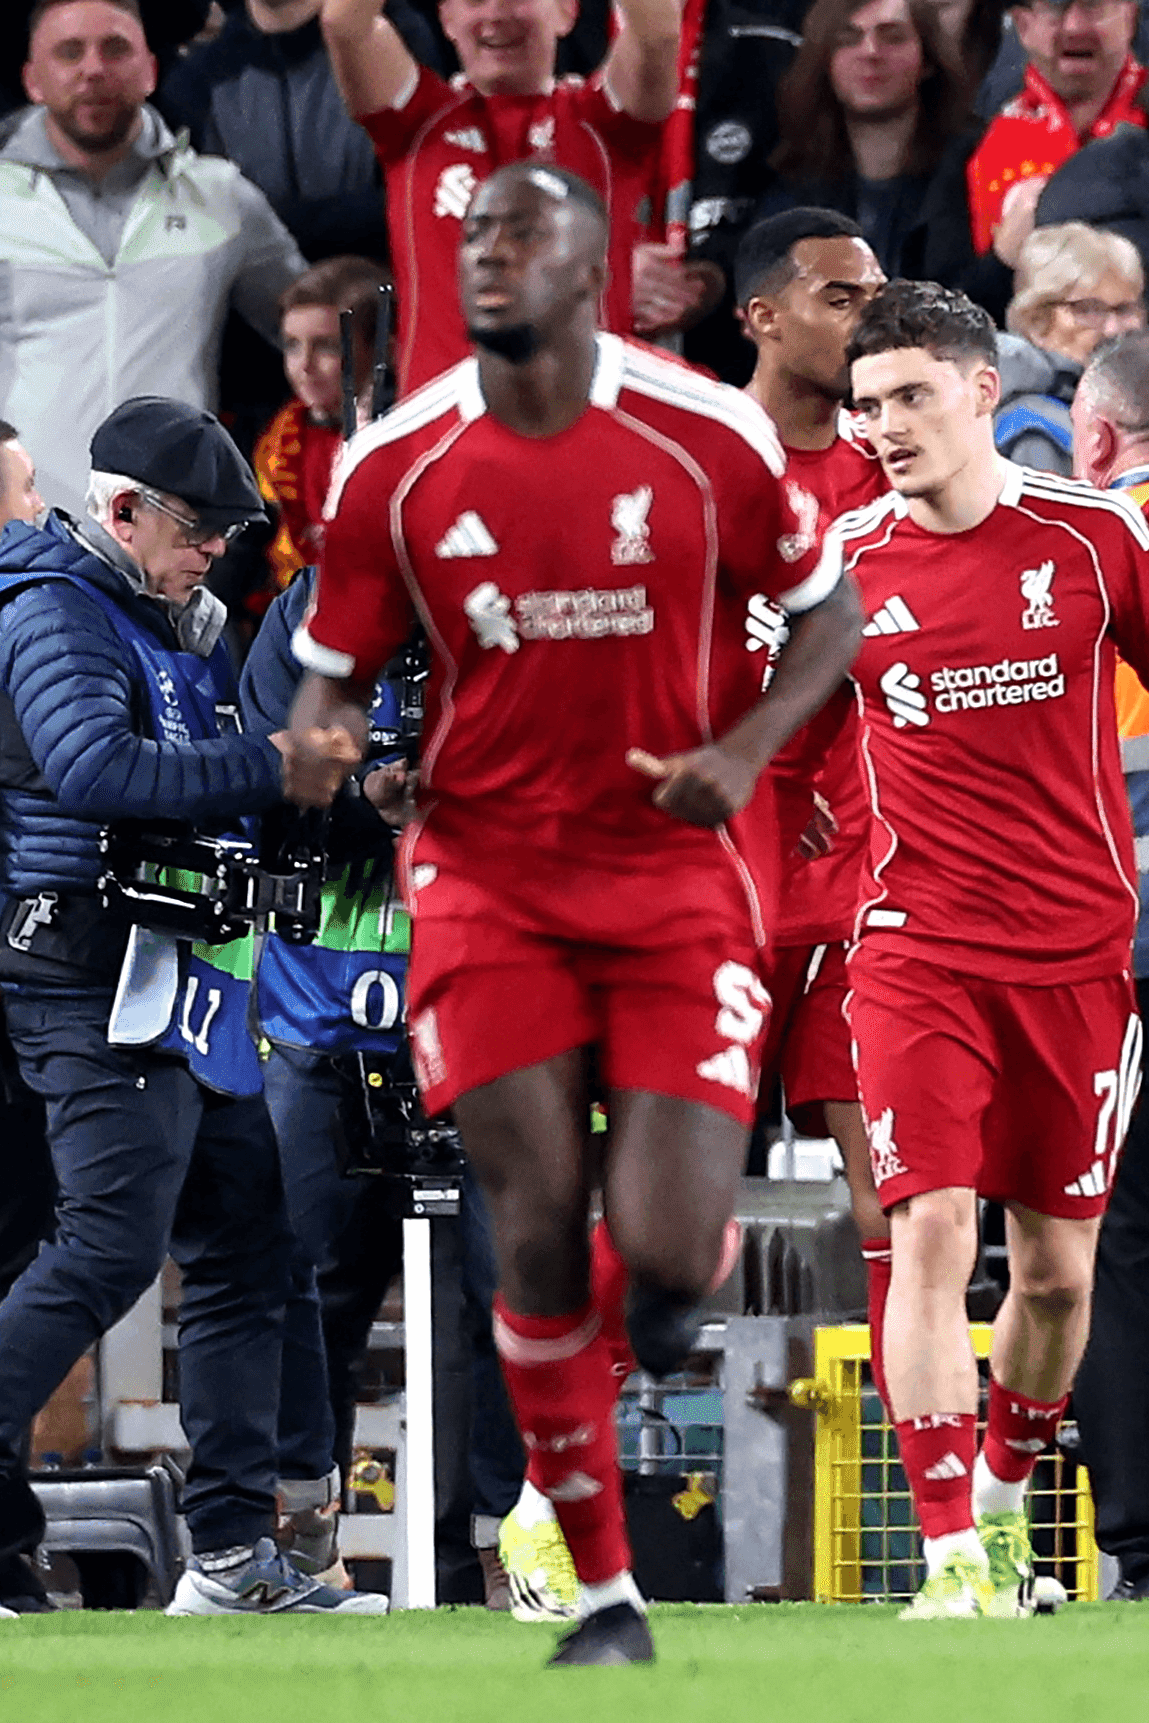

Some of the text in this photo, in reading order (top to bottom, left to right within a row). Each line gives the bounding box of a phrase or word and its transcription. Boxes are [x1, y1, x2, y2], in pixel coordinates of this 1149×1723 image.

[930, 653, 1058, 692] standard
[934, 673, 1065, 713] chartered
[1094, 1069, 1118, 1156] 7
